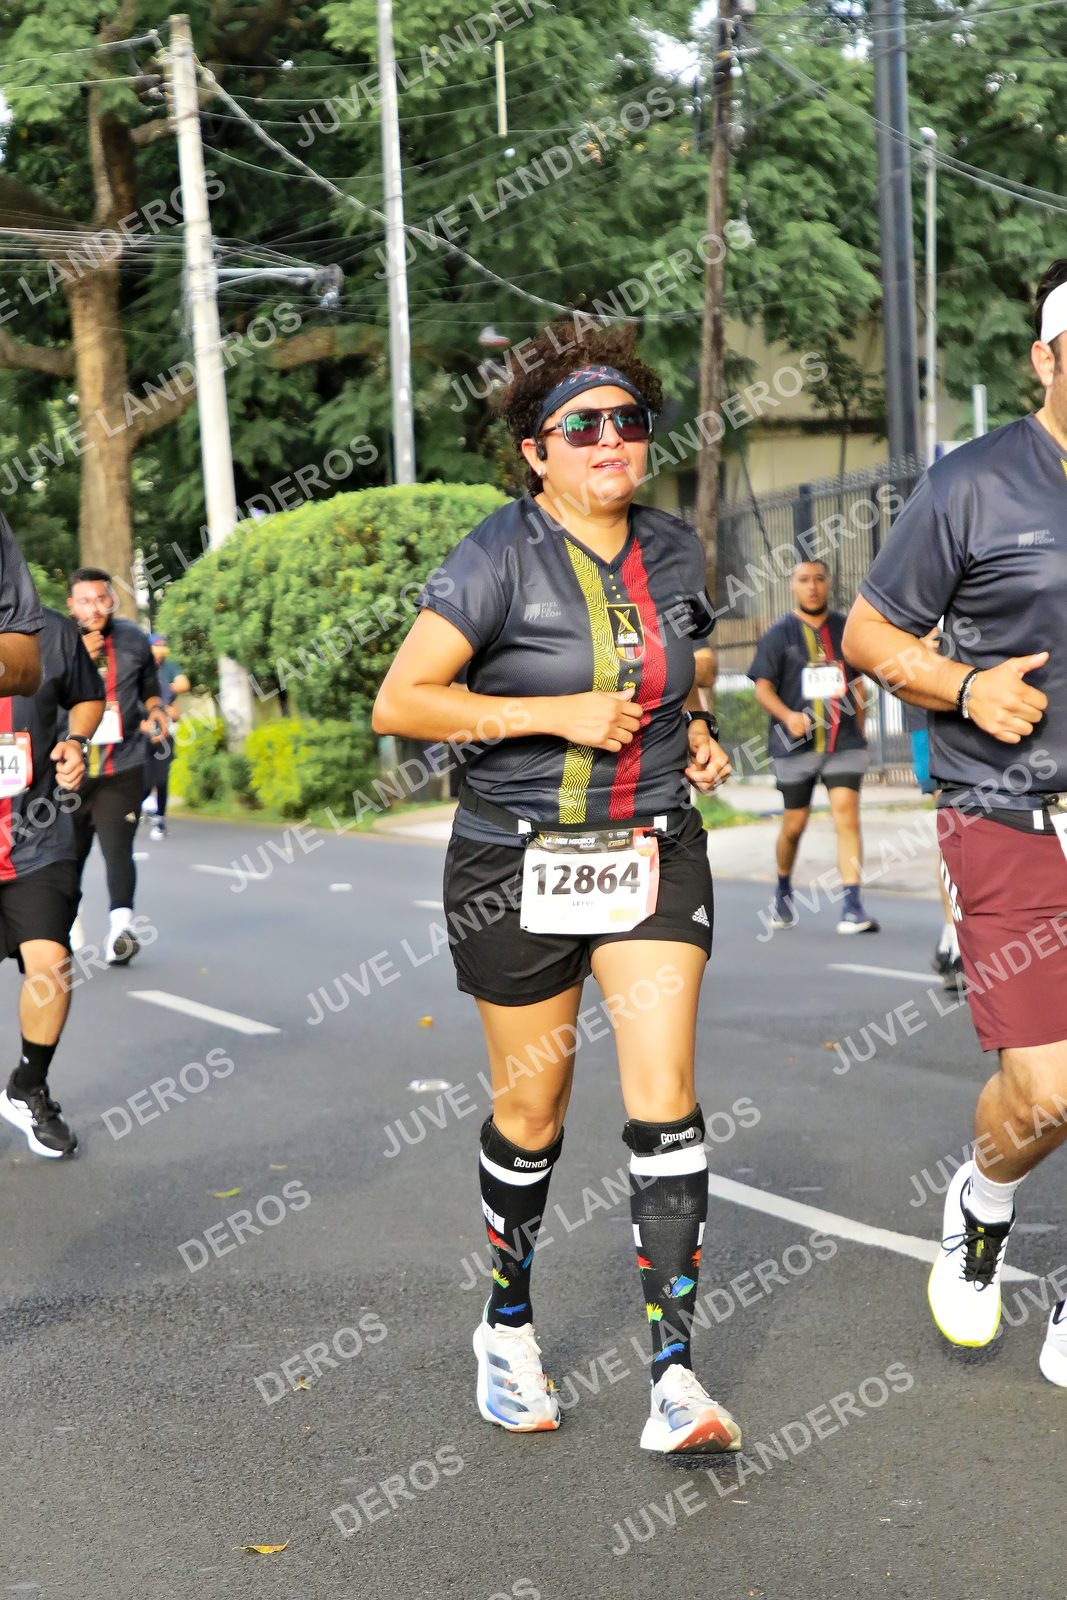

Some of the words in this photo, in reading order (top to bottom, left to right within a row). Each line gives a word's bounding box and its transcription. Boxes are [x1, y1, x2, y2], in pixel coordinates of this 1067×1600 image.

[532, 862, 641, 895] 12864
[660, 1126, 695, 1145] GOUNOD
[513, 1156, 548, 1169] GOUNOD
